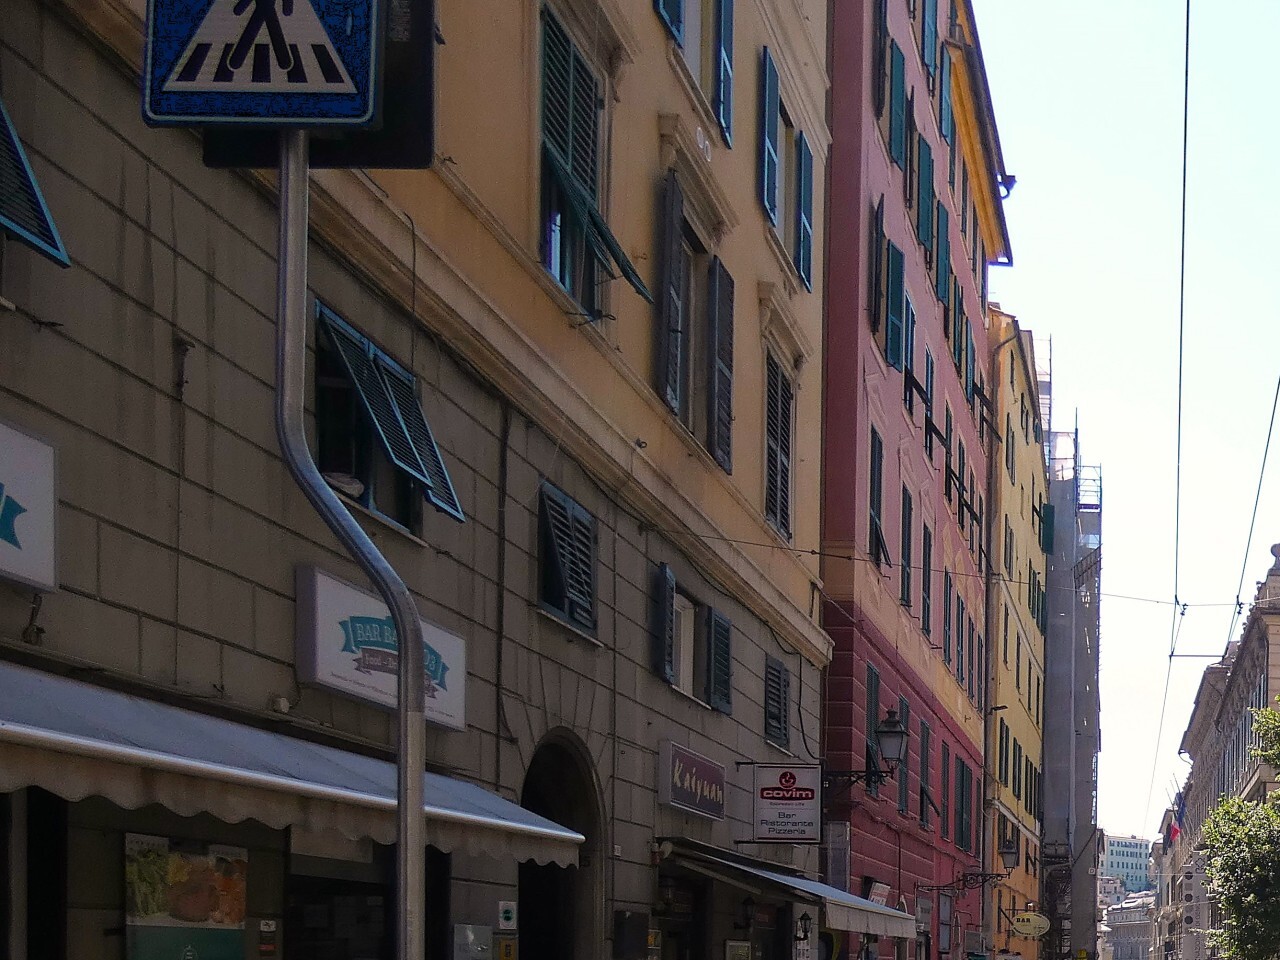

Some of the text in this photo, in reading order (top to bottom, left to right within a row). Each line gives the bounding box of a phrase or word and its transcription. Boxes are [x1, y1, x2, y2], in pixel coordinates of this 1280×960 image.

[355, 623, 382, 642] BAR
[673, 758, 723, 804] Kaiyuan
[762, 787, 812, 799] covim
[760, 819, 814, 827] Ristorante
[768, 827, 806, 835] Pizzeria
